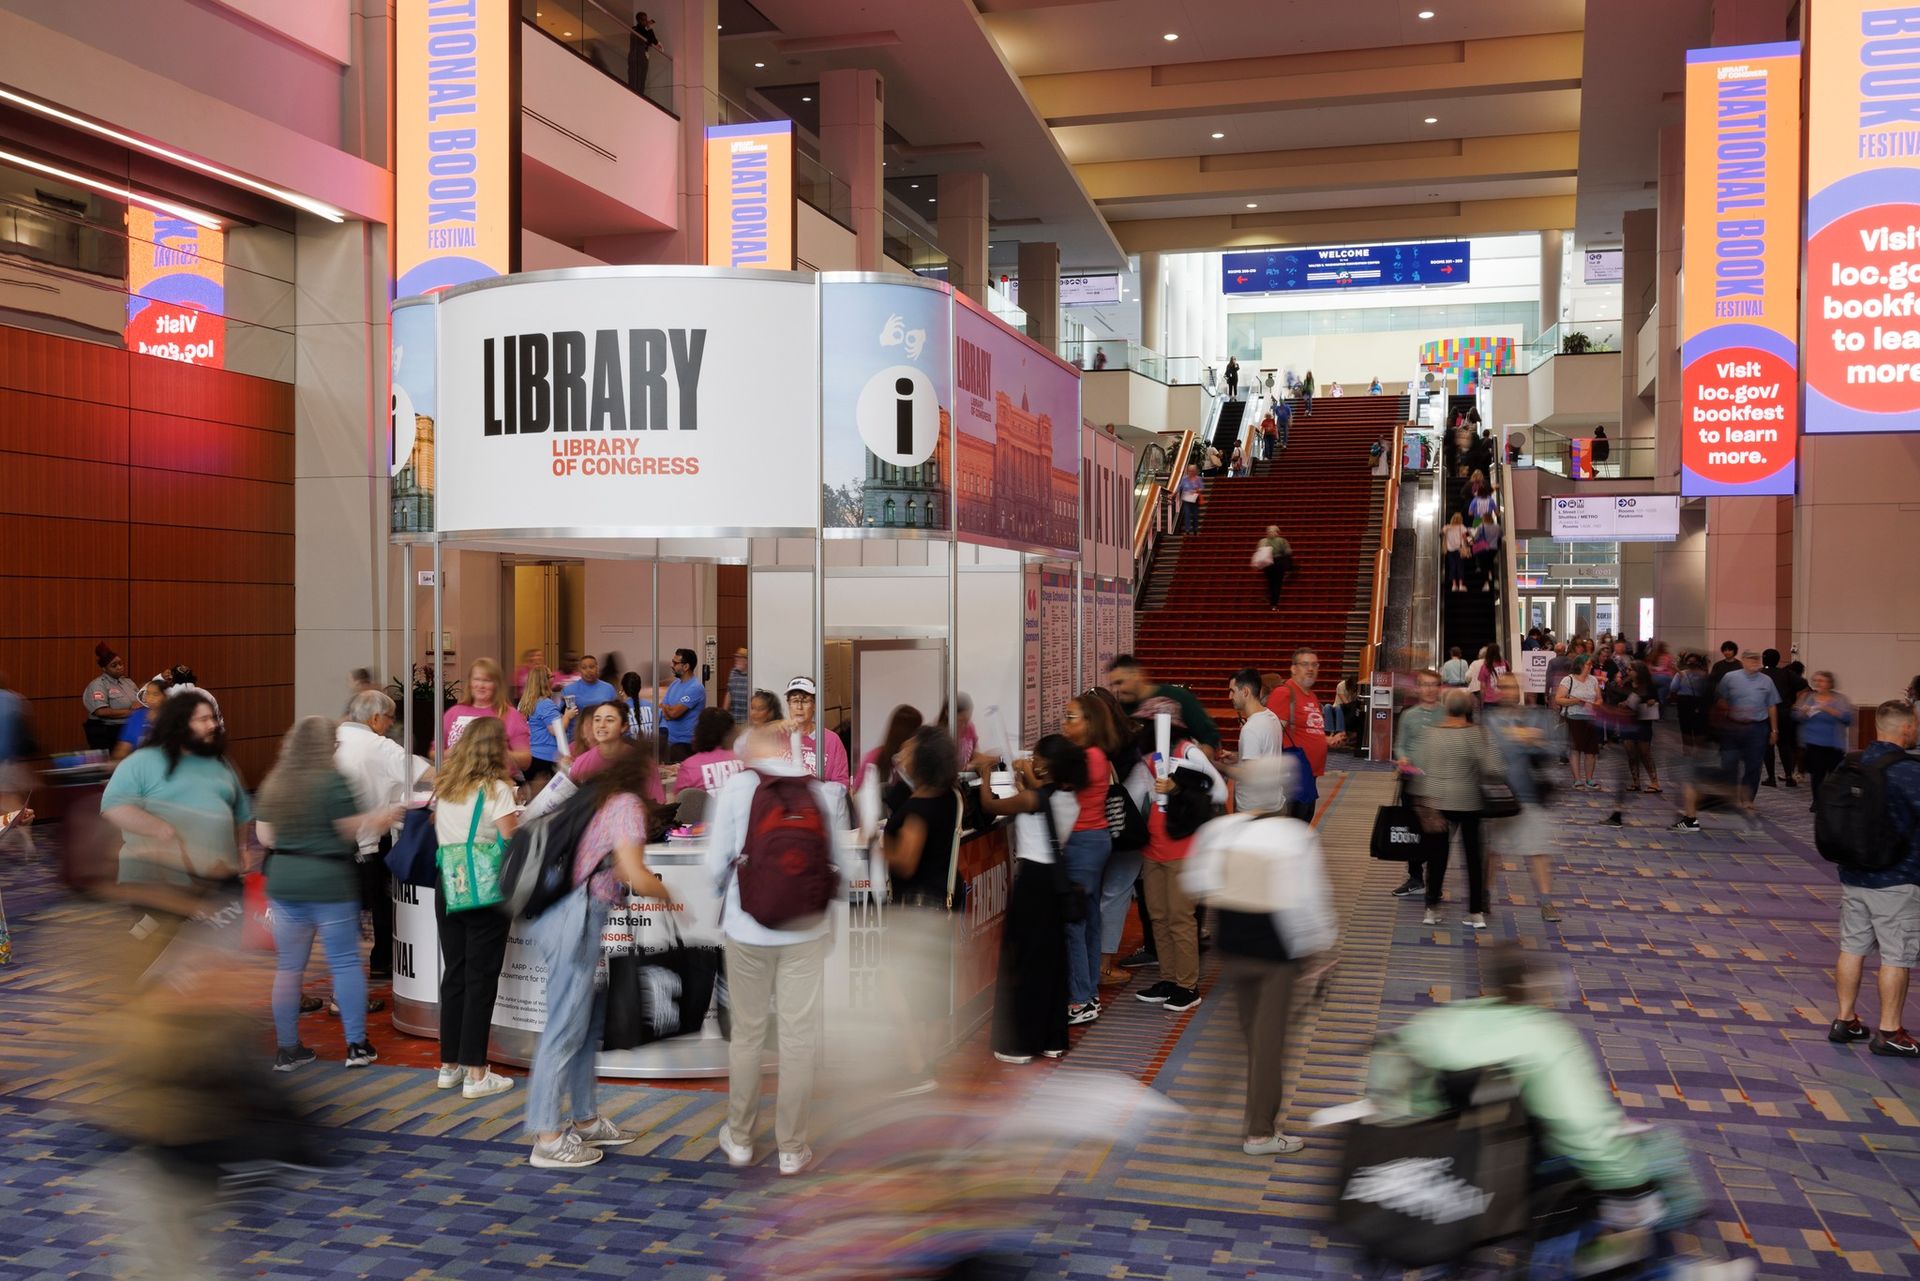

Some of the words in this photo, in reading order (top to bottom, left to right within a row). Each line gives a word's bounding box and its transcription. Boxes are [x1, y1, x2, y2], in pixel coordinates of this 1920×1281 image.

[428, 0, 476, 121] TIONAL
[1859, 8, 1920, 128] BOOK
[1717, 79, 1766, 213] NATIONAL
[1859, 131, 1920, 158] FESTIV
[428, 129, 476, 224] BOOK
[732, 152, 767, 268] NATIONAL
[428, 227, 476, 249] FESTIVAL
[1319, 249, 1370, 259] WELCOME
[1716, 219, 1764, 297] BOOK
[1832, 262, 1920, 290] loc.go
[1716, 301, 1763, 317] FESTIVAL
[1832, 329, 1865, 351] to
[1874, 326, 1920, 351] lea
[1716, 362, 1761, 378] Visit
[1847, 364, 1920, 384] more
[484, 329, 707, 436] LIBRARY
[1699, 384, 1779, 403] loc.gov/
[1693, 405, 1784, 422] bookfest
[1699, 428, 1720, 443] to
[1726, 427, 1777, 443] learn
[553, 438, 639, 457] LIBRARY
[1709, 451, 1767, 464] more.
[553, 459, 577, 476] OF
[582, 457, 699, 476] CONGRESS
[601, 934, 634, 942] NSORS
[511, 963, 527, 971] AARP
